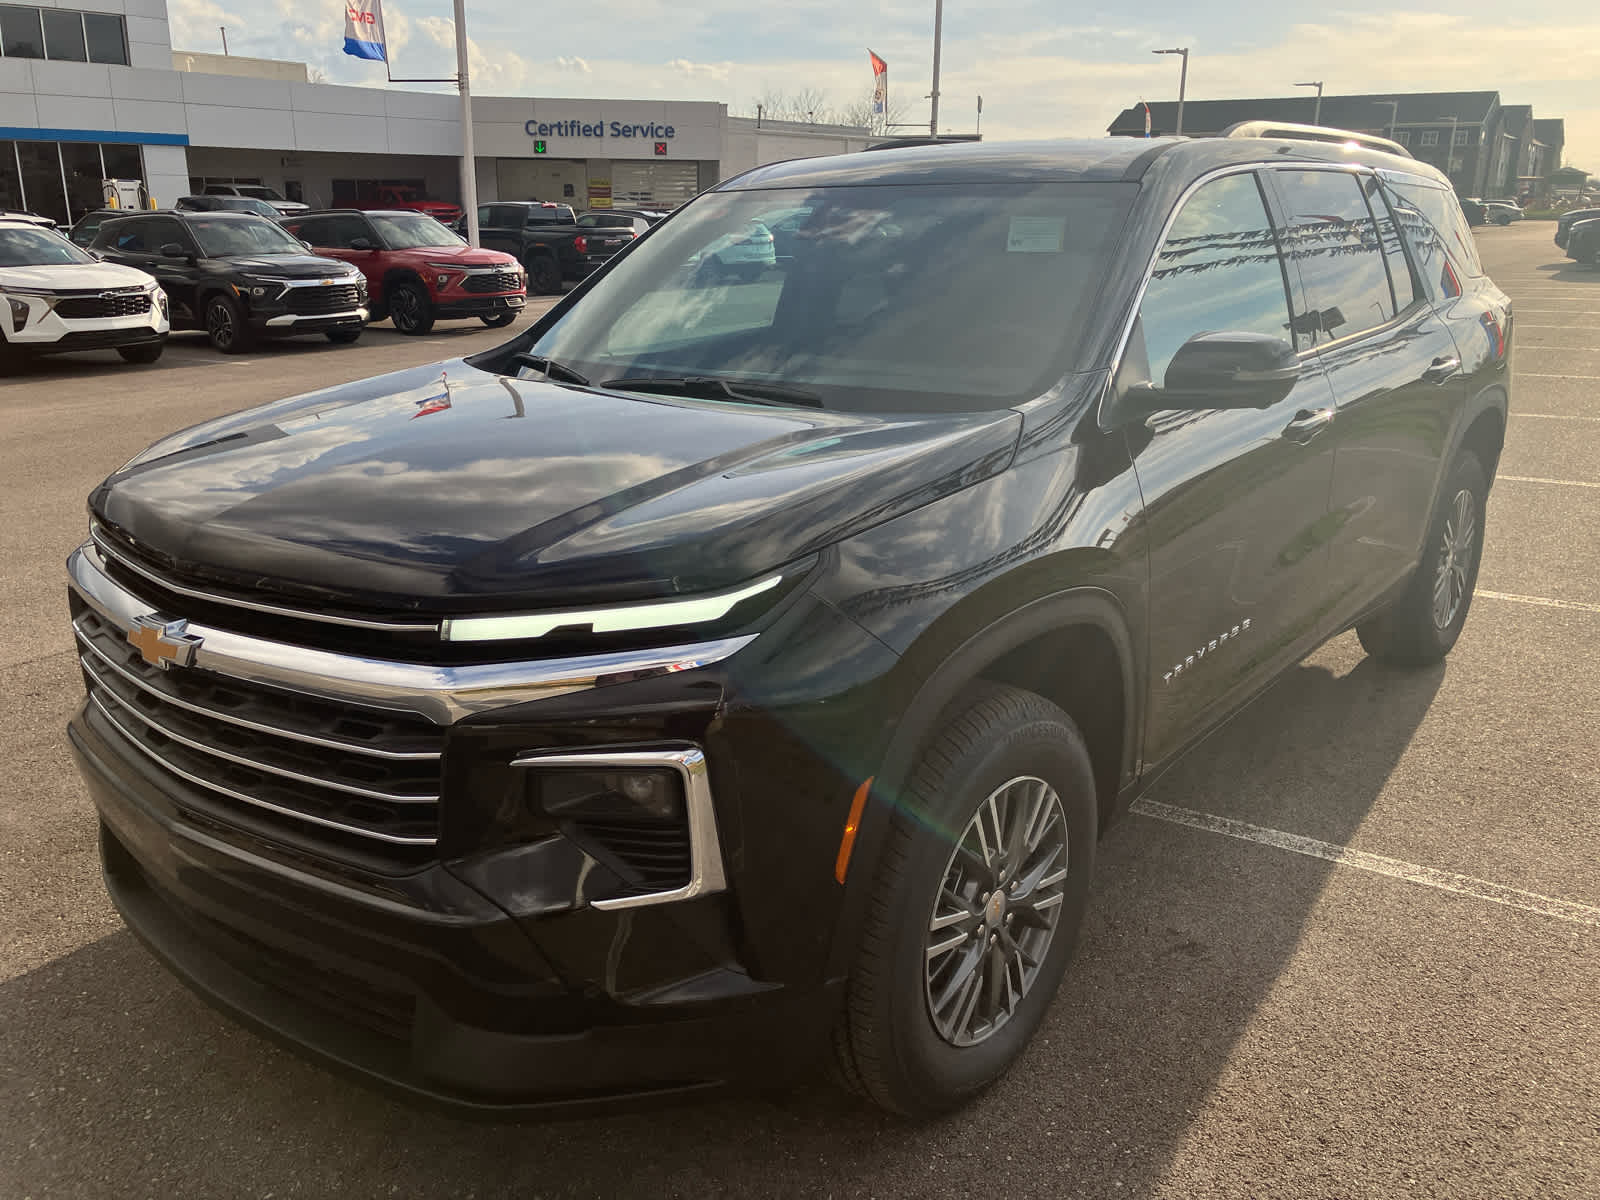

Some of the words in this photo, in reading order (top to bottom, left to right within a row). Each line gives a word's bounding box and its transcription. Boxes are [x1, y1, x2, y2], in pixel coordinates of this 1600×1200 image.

[525, 119, 605, 138] Certified
[610, 121, 675, 139] Service
[1163, 618, 1252, 686] TRAVERSE
